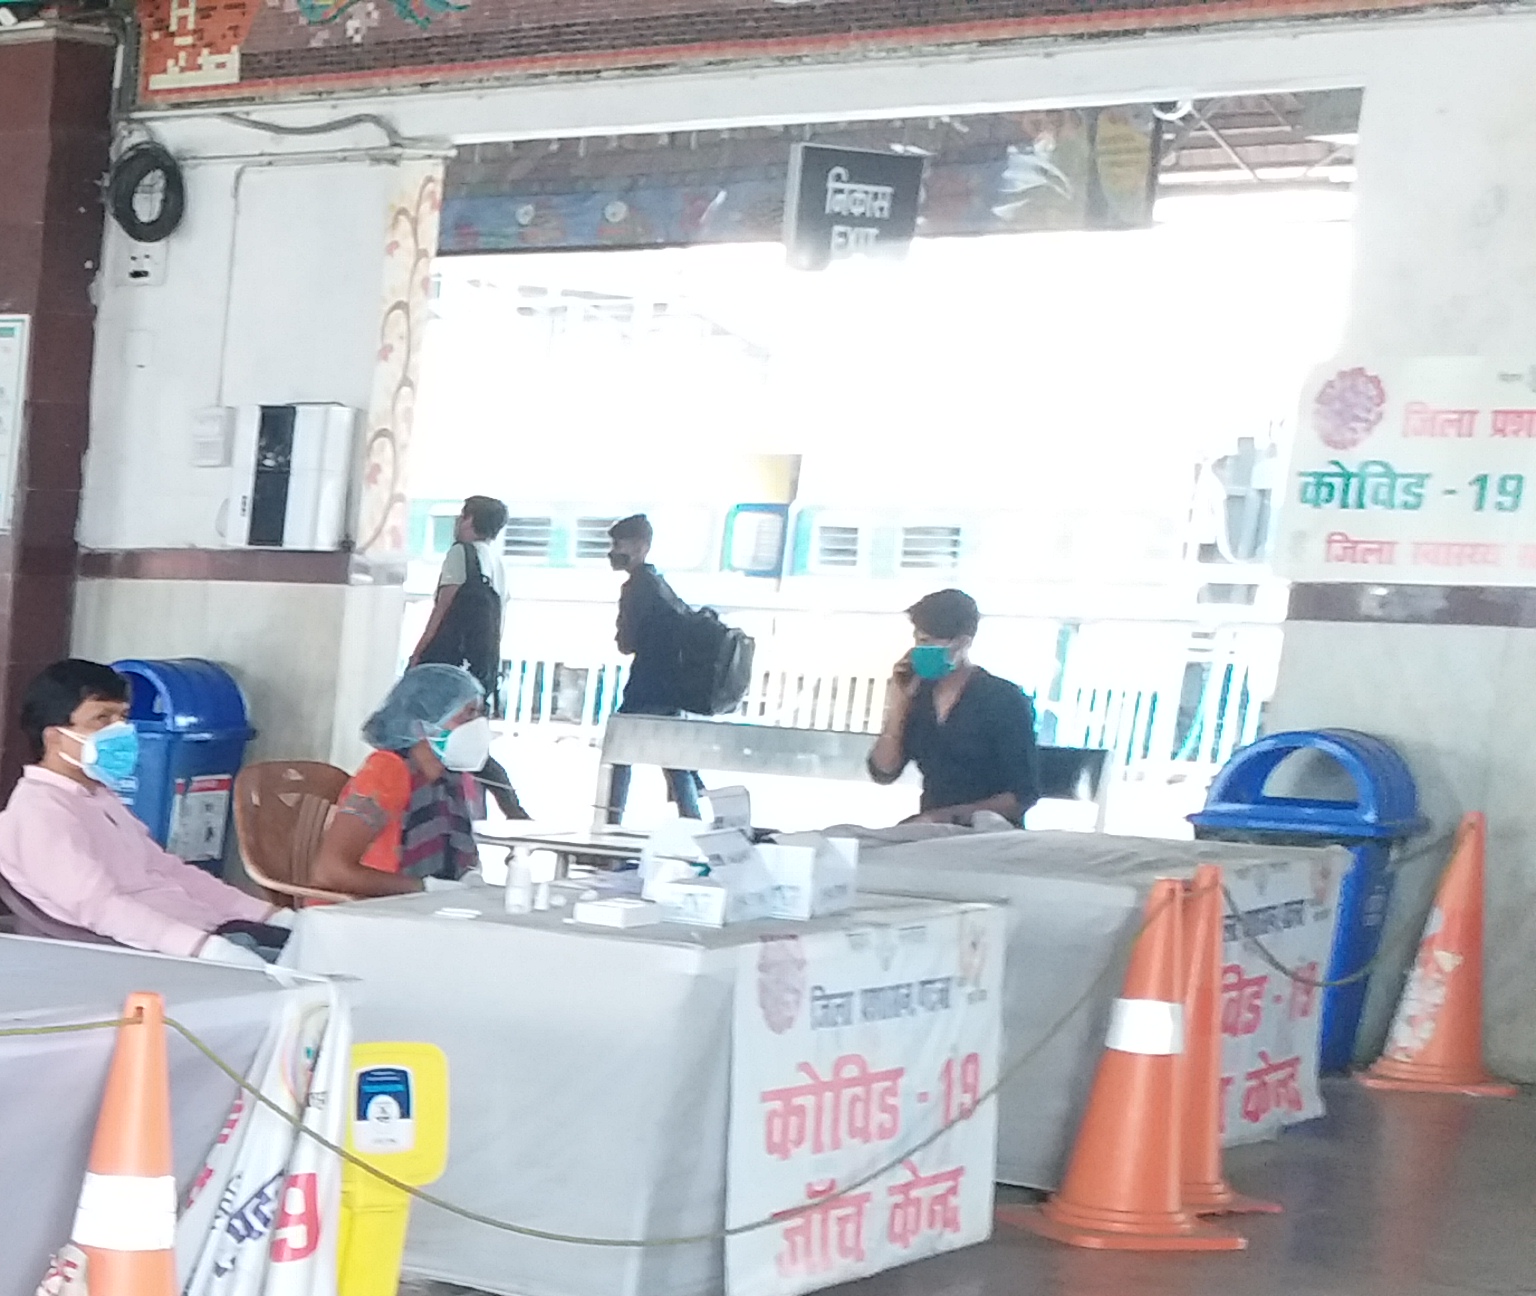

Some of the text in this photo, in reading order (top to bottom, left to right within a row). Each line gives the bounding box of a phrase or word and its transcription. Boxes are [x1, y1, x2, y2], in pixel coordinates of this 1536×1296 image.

[824, 165, 895, 220] निकास
[1295, 459, 1433, 511] कोविड
[1467, 472, 1526, 513] 19
[1324, 530, 1400, 566] जिला
[760, 1053, 905, 1162] कोविड
[940, 1052, 981, 1126] 19
